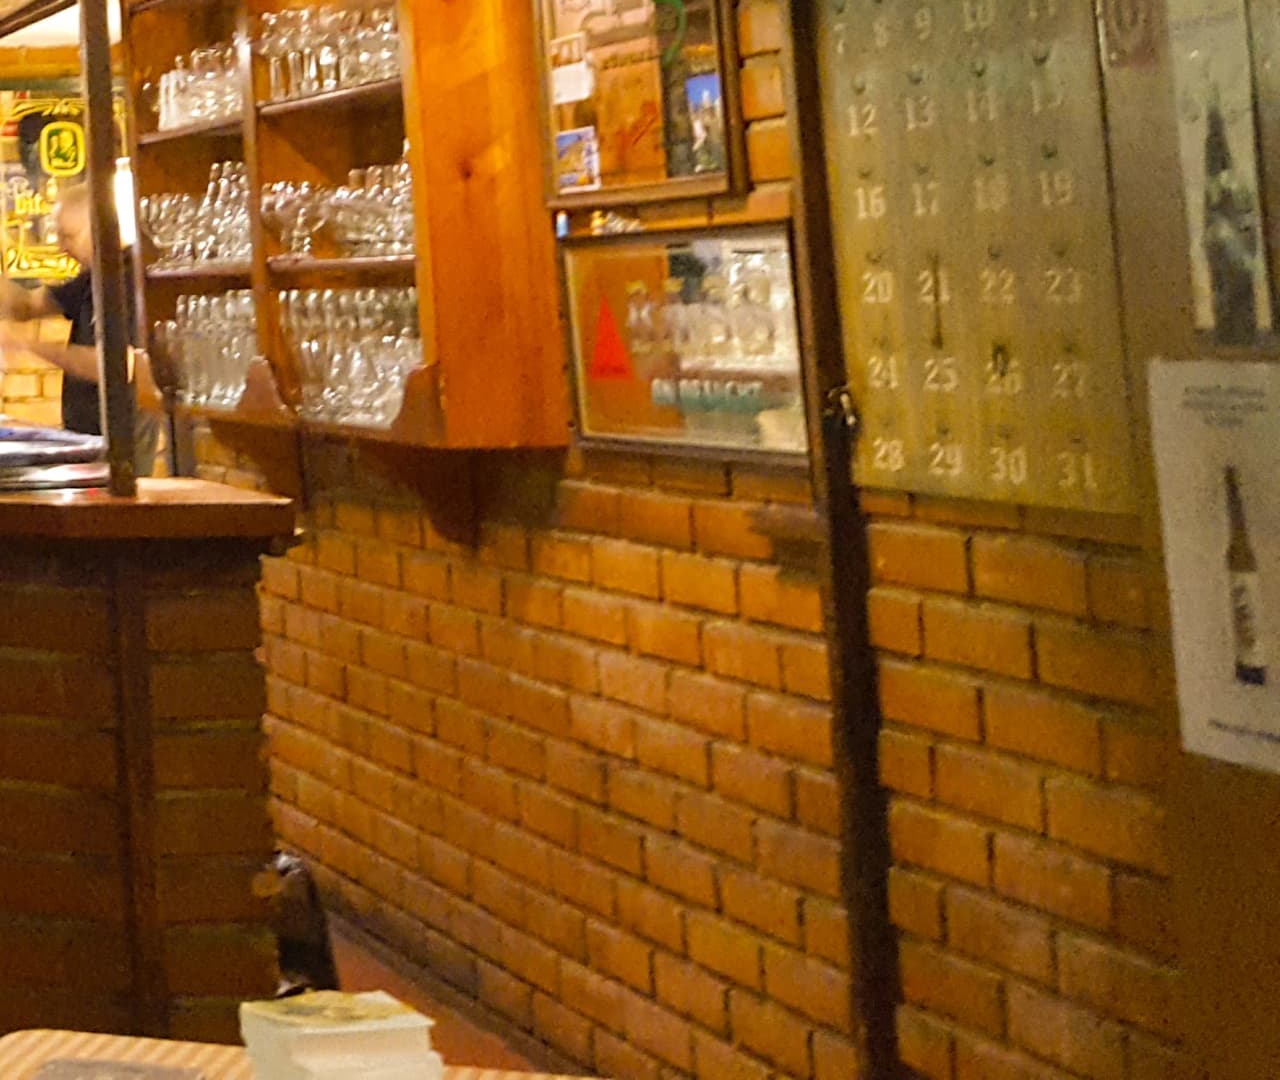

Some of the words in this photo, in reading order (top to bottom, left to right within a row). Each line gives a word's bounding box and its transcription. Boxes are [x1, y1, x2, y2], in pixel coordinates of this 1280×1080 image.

[832, 22, 846, 56] 7
[914, 6, 932, 41] 9
[846, 103, 878, 138] 12
[904, 95, 937, 132] 13
[965, 87, 998, 123] 14
[853, 185, 887, 220] 16
[912, 180, 941, 217] 17
[973, 174, 1010, 213] 18
[1039, 170, 1073, 208] 19
[861, 271, 894, 305] 20
[918, 269, 952, 305] 21
[978, 268, 1016, 306] 22
[1044, 267, 1084, 305] 23
[867, 355, 900, 390] 24
[924, 356, 959, 392] 25
[985, 358, 1025, 395] 26
[1051, 360, 1088, 399] 27
[872, 436, 906, 472] 28
[928, 440, 964, 478] 29
[989, 444, 1028, 486] 30
[1055, 450, 1098, 490] 31
